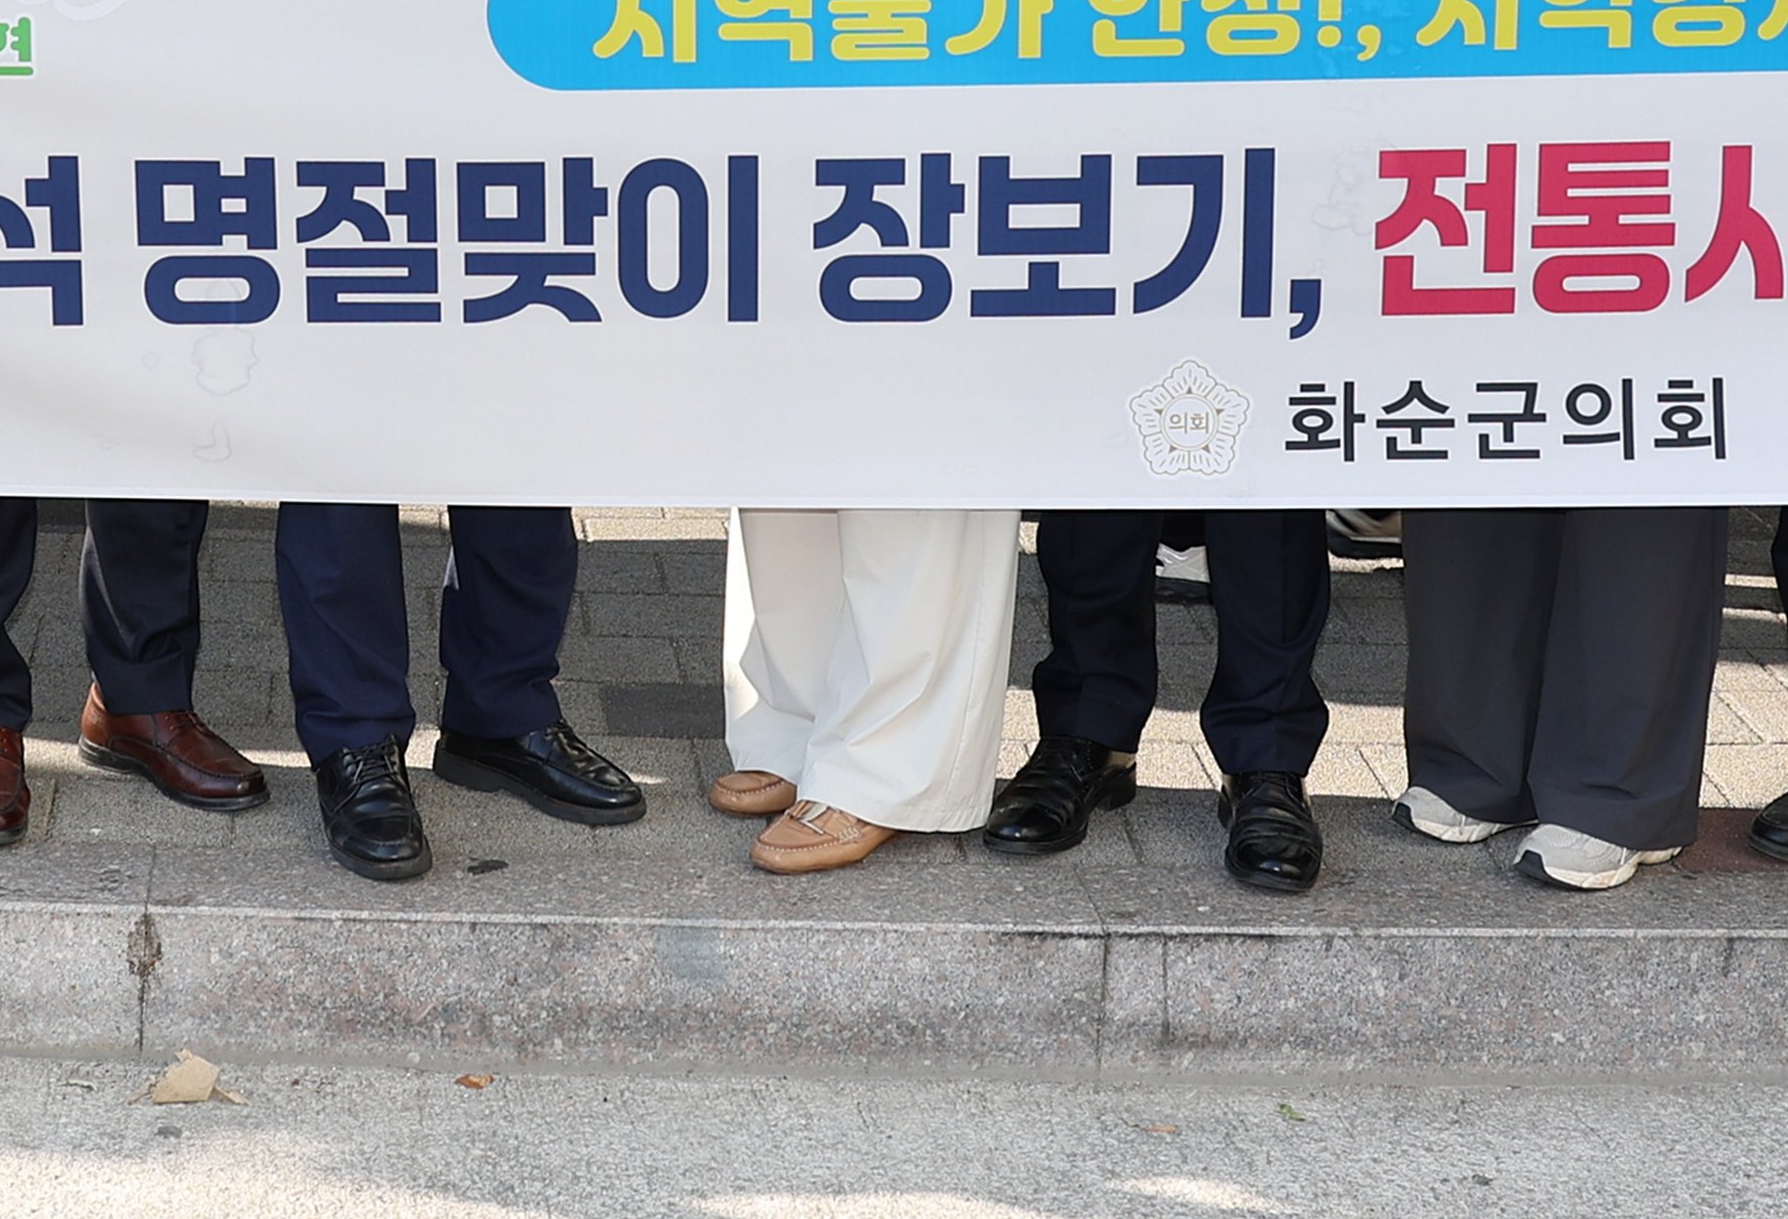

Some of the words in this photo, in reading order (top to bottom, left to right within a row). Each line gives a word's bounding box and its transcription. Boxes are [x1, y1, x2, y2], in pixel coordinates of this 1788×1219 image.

[134, 155, 758, 326] 명절맞이
[813, 148, 1322, 340] 장보기,
[1167, 412, 1211, 435] 의회
[1285, 377, 1727, 462] 화순군의회
